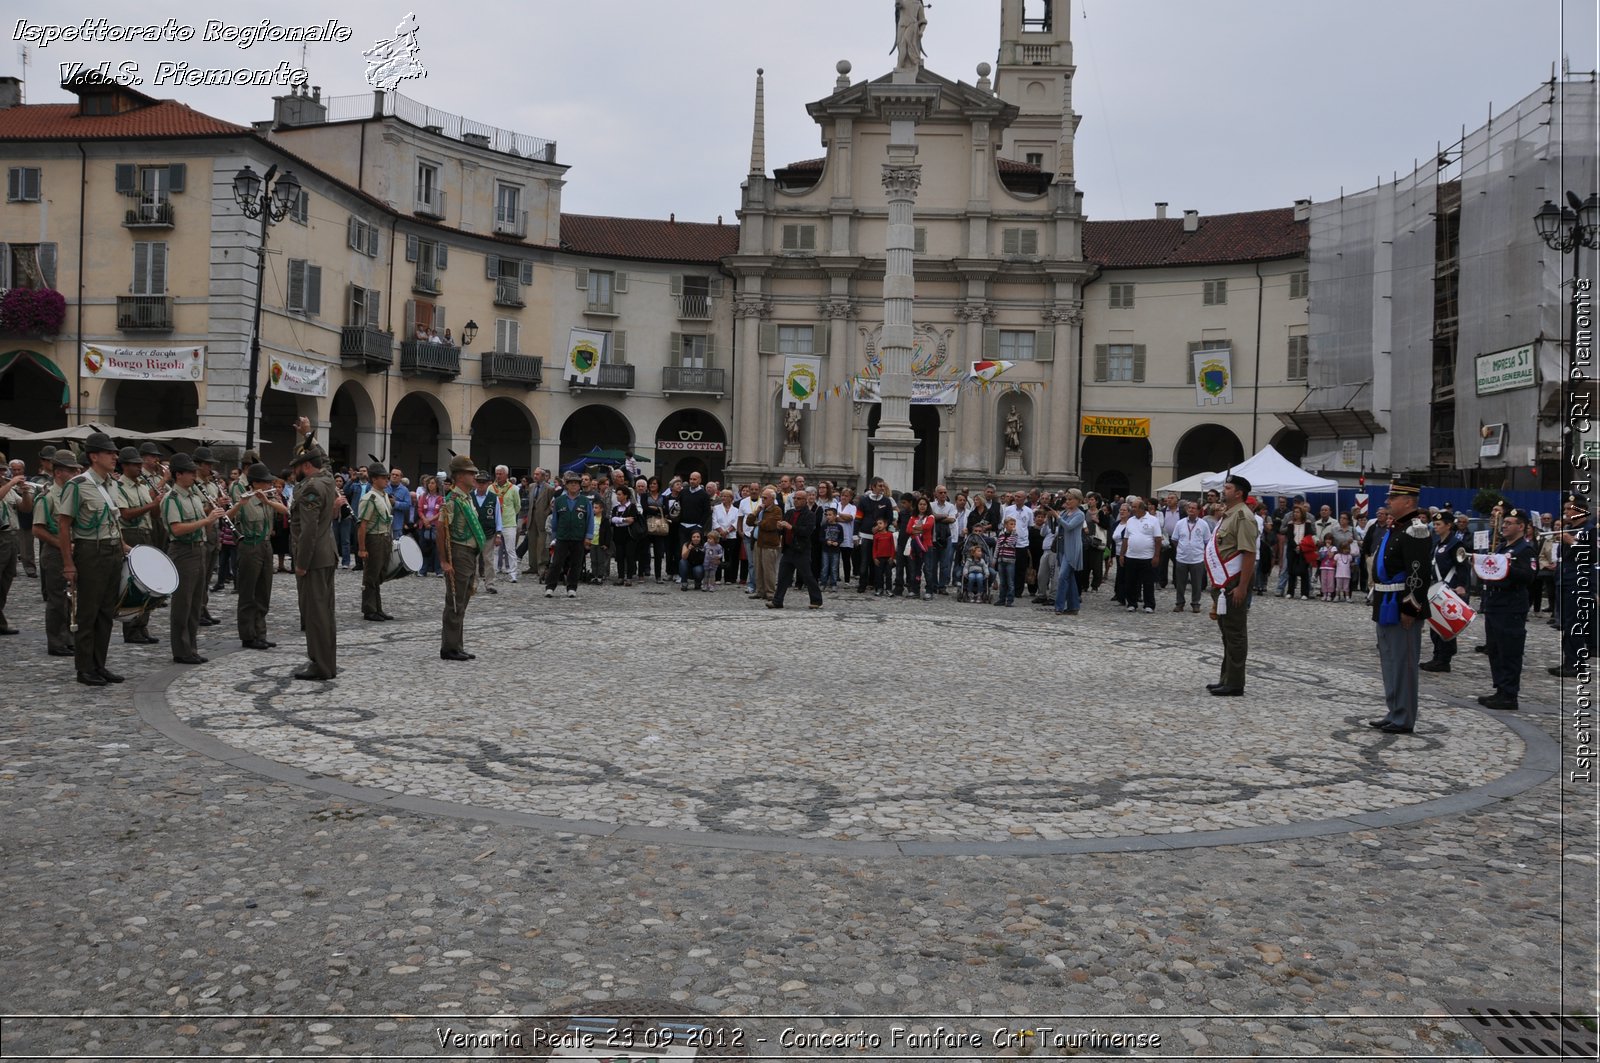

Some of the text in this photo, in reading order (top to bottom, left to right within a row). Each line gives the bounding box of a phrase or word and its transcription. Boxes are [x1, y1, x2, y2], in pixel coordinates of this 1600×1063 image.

[108, 357, 143, 370] Borgo
[1492, 349, 1530, 372] IMPRESA ST
[1501, 368, 1533, 381] GENERALE
[1095, 417, 1124, 426] BANCO
[1084, 425, 1146, 436] BENEFICENZA
[658, 441, 722, 450] FOTO OTTICA
